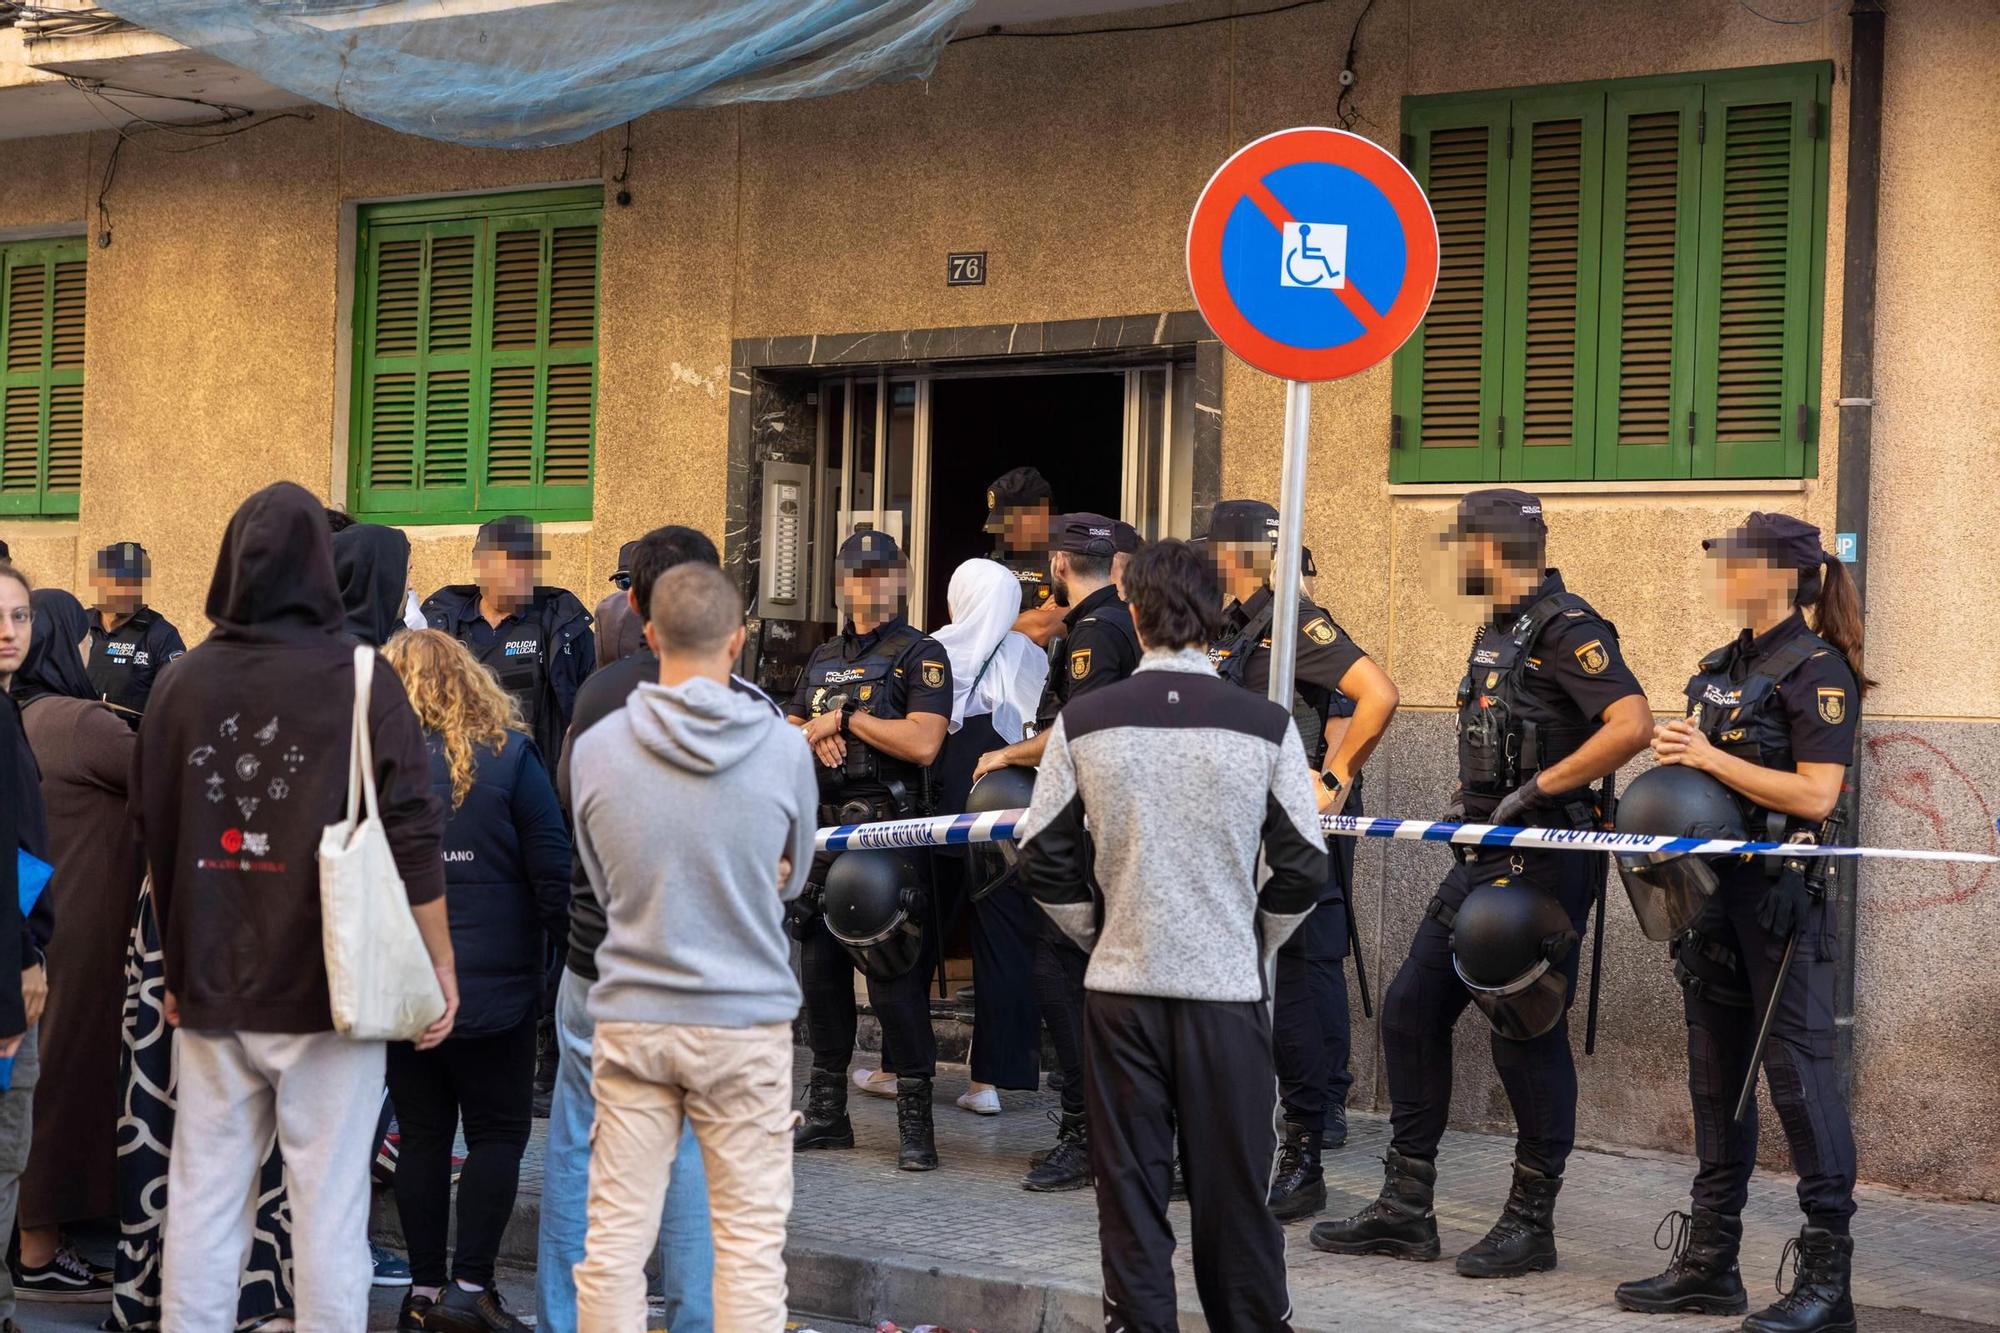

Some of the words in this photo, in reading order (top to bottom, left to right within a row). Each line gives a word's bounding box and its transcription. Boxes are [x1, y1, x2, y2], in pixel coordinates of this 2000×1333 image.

[953, 258, 979, 279] 76
[107, 641, 136, 650] POLICIA
[505, 641, 537, 649] POLICIA
[516, 647, 537, 655] LOCAL
[440, 850, 475, 862] LANO
